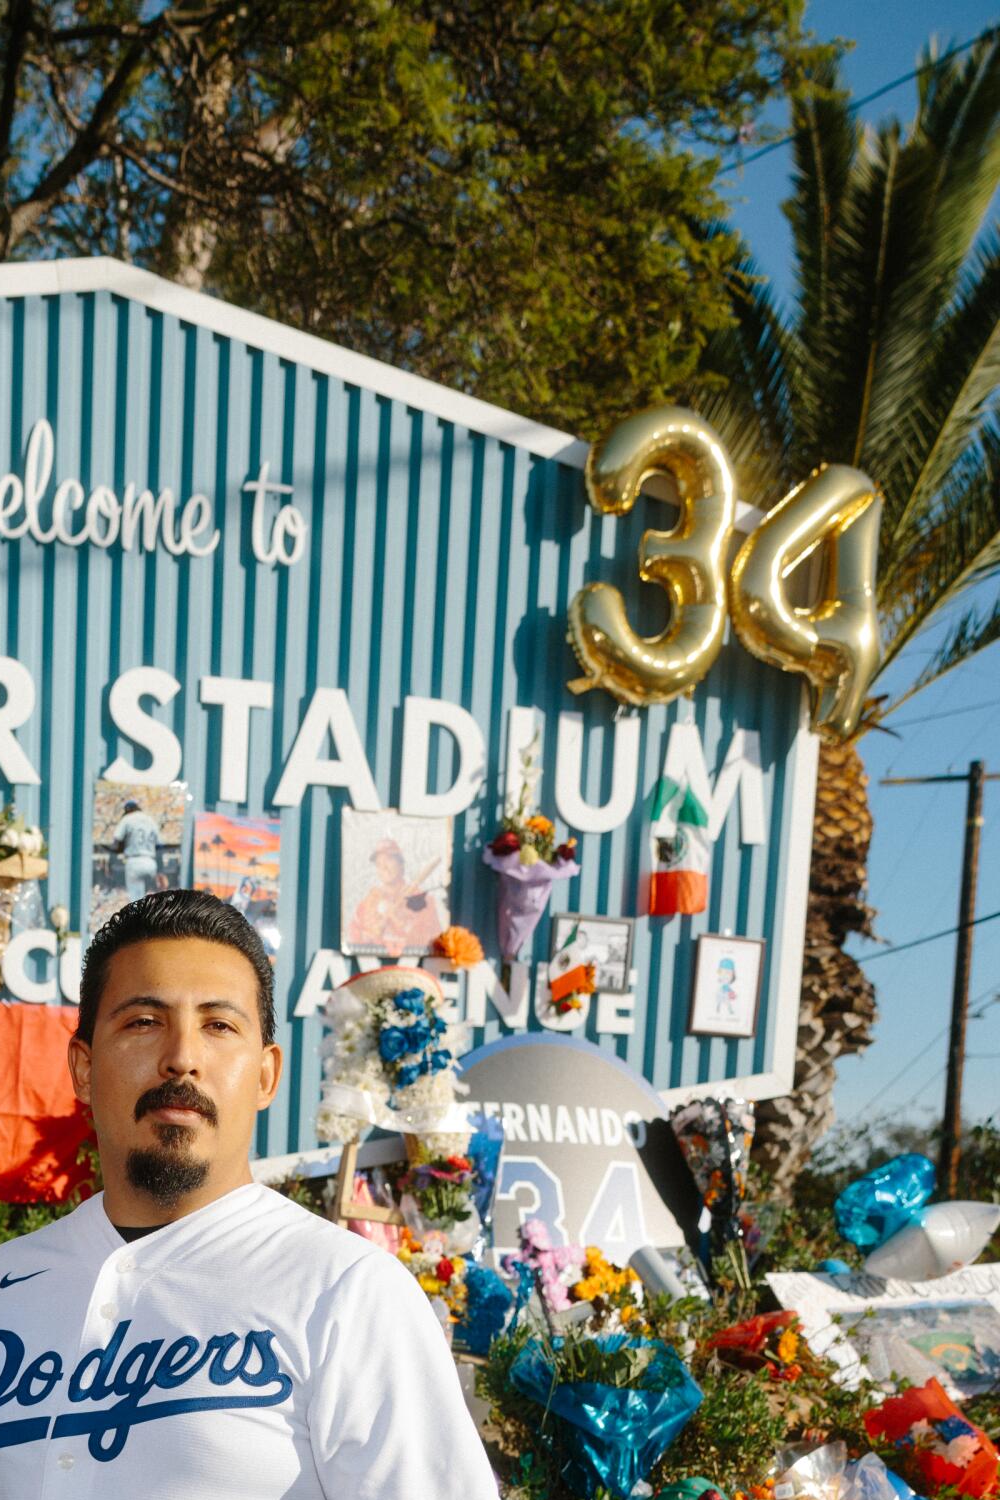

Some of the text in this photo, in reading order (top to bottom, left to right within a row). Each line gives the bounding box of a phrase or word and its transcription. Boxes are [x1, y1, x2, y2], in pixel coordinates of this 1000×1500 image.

[243, 461, 307, 566] to
[567, 406, 883, 741] 34
[103, 666, 766, 846] STADIUM
[492, 1155, 655, 1279] 34
